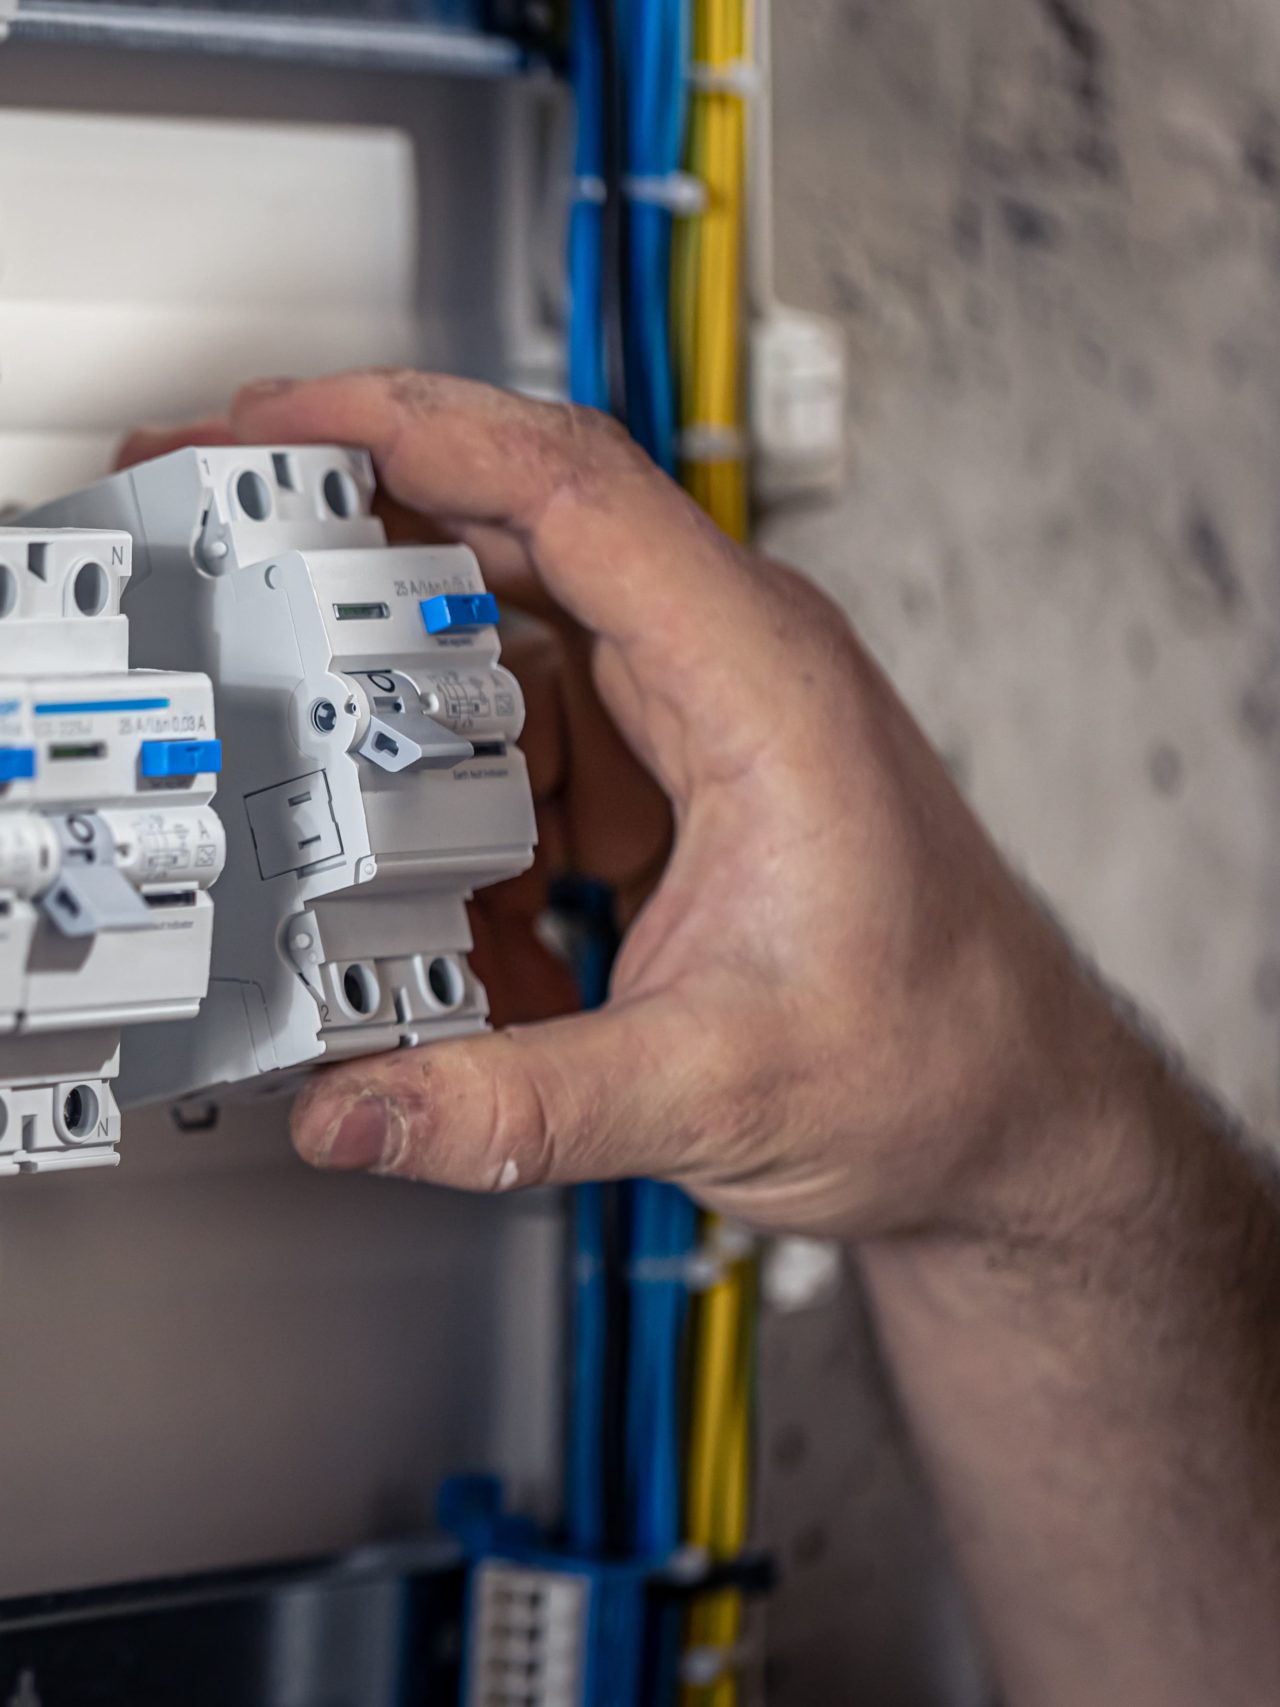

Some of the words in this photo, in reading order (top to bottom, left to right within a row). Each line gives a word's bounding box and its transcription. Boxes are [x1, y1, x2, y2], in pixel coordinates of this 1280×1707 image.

[111, 545, 124, 566] N
[197, 713, 207, 732] A
[320, 1004, 332, 1023] 2
[97, 1116, 110, 1138] N
